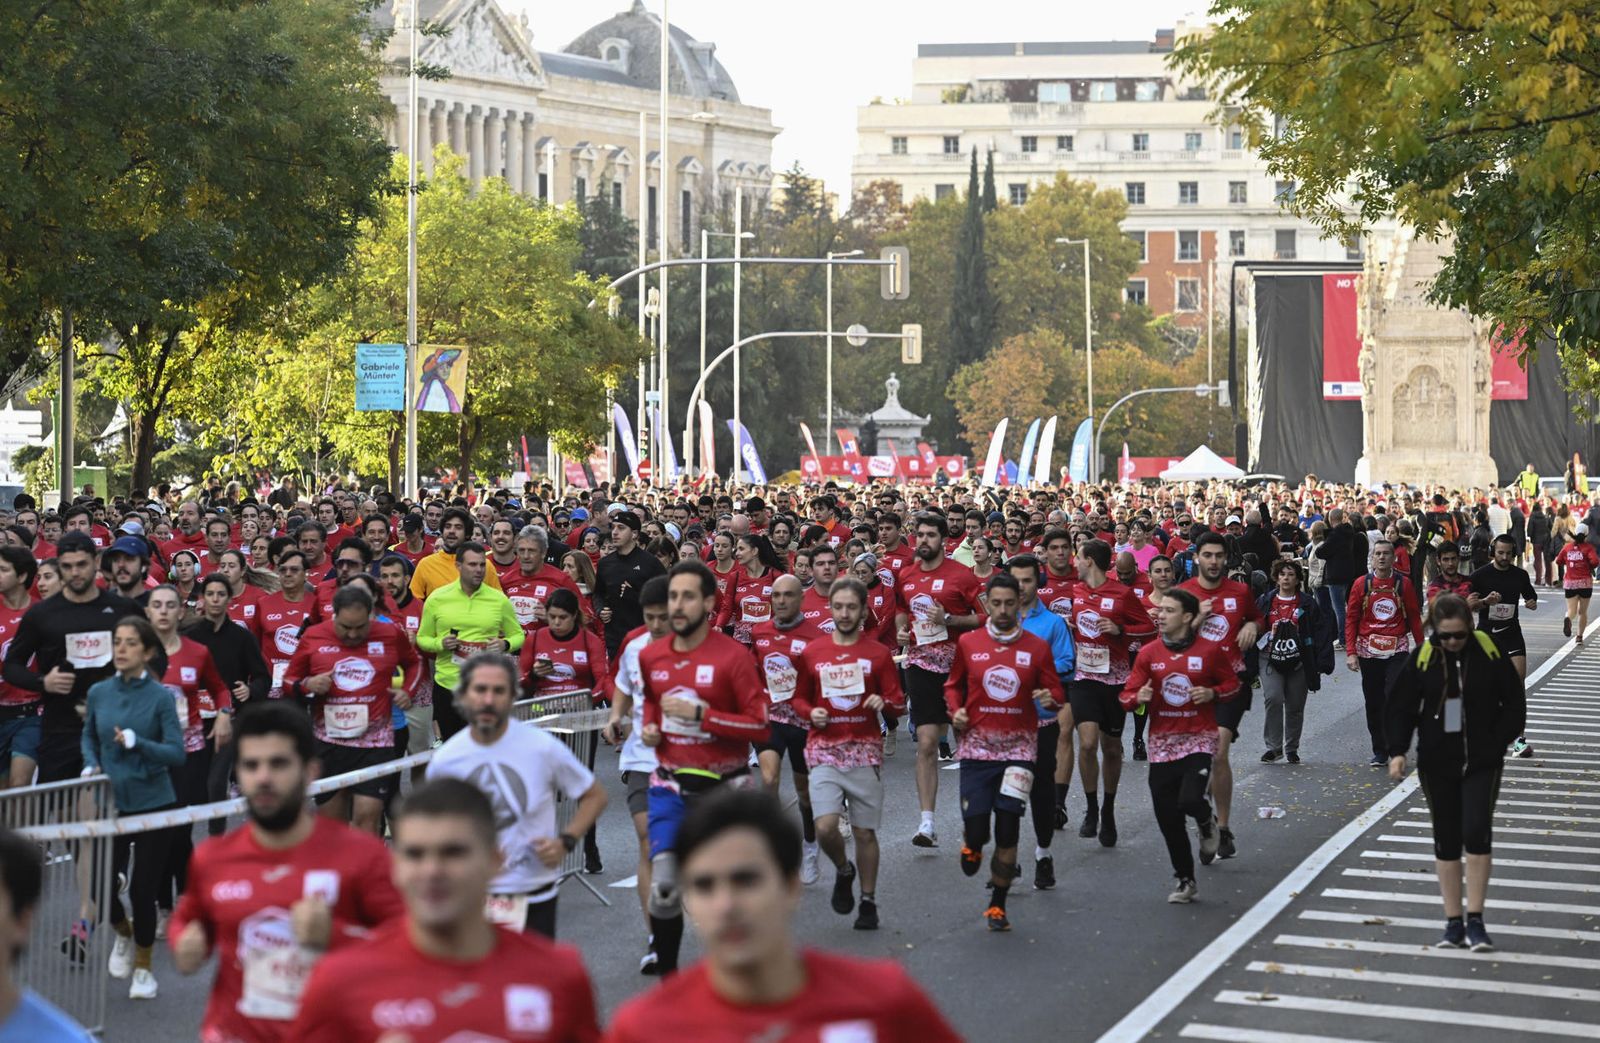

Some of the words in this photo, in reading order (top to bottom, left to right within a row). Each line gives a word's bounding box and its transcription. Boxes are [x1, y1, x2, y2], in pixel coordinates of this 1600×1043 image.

[1336, 279, 1351, 288] NO
[360, 363, 400, 371] Gabriele
[363, 372, 396, 380] Münter
[913, 601, 929, 610] PONL
[990, 673, 1016, 686] PONLE
[987, 680, 1014, 693] FRENO
[979, 706, 1006, 714] MADRID
